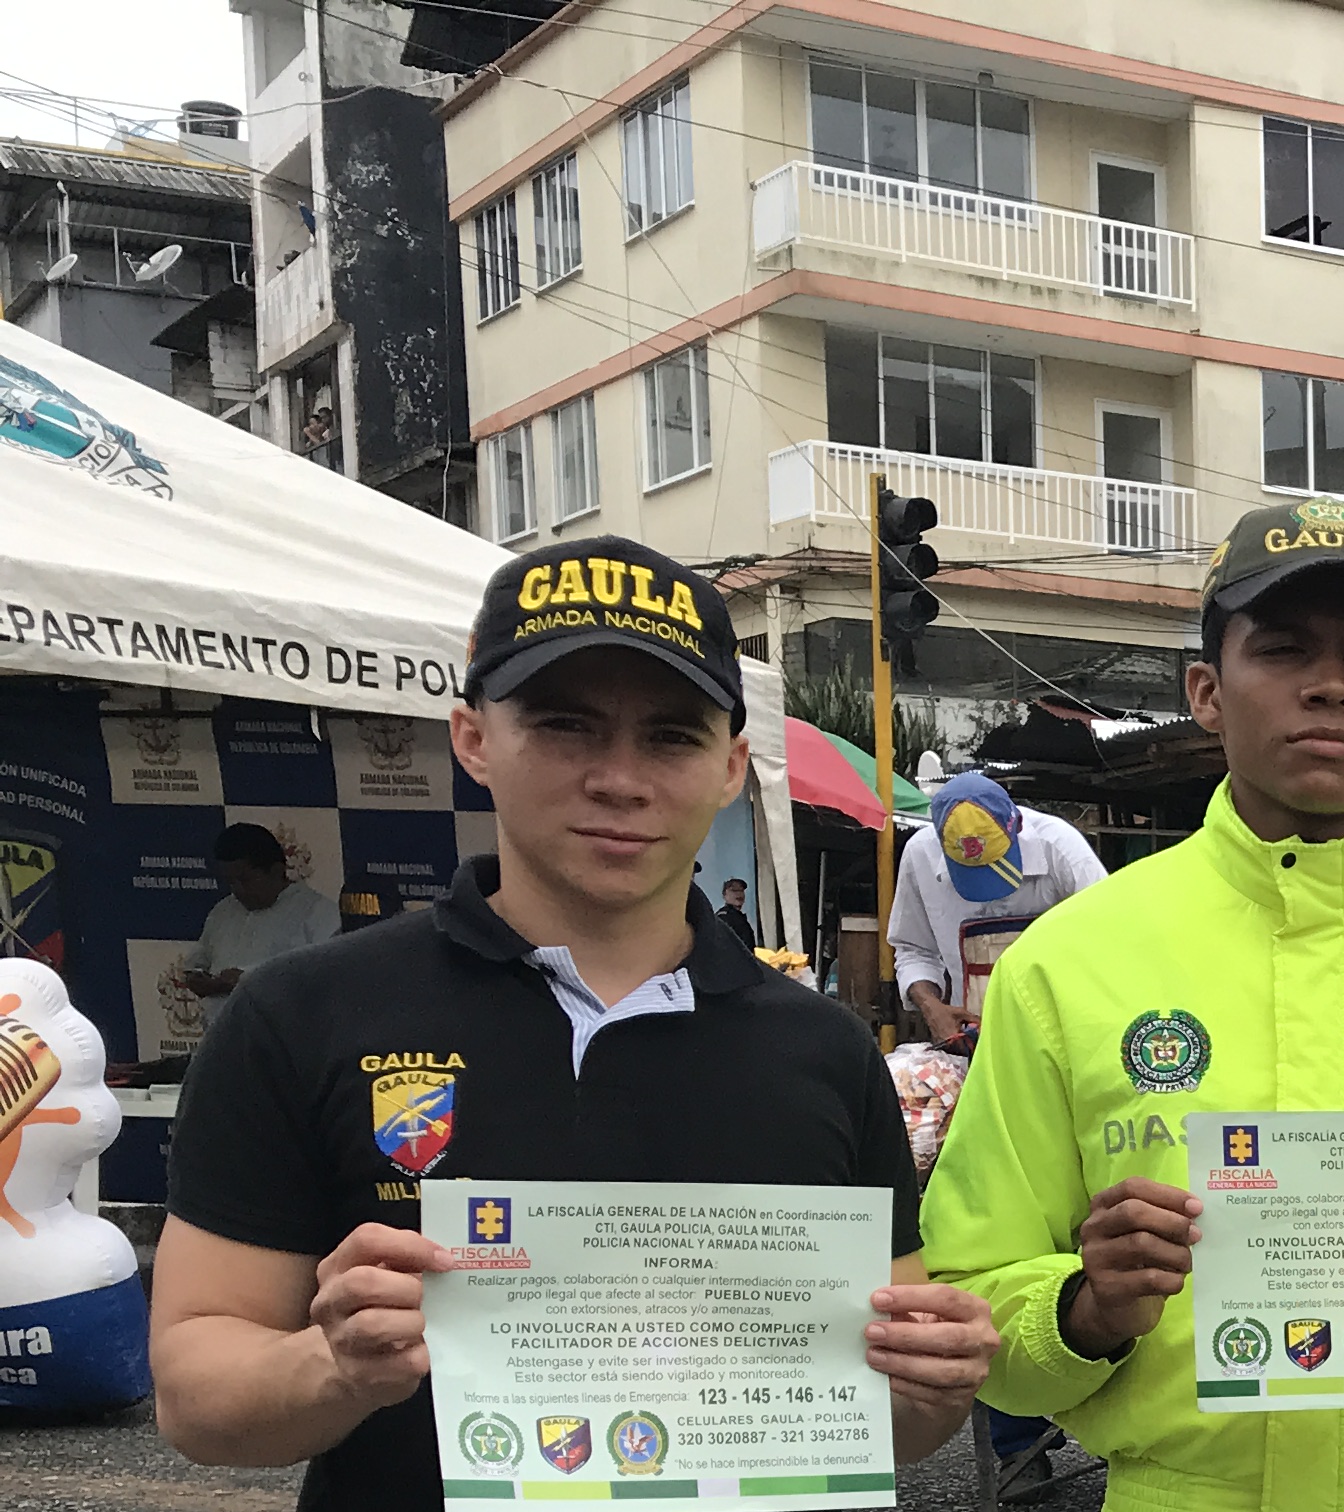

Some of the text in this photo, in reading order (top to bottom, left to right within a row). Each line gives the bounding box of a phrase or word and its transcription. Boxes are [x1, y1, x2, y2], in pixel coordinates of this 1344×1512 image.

[517, 558, 703, 631] GAULA
[514, 609, 705, 659] ARMADA NACIONAL
[326, 647, 379, 688] DE
[396, 656, 467, 699] POL
[21, 766, 86, 798] UNIFICADA
[19, 792, 86, 824] PERSONAL
[361, 1053, 466, 1072] GAULA
[377, 1074, 448, 1093] GAULA
[1210, 1168, 1274, 1180] FISCALIA
[1247, 1237, 1265, 1248] LO
[644, 1258, 719, 1269] INFORMA:
[705, 1289, 811, 1302] PUEBLO NUEVO
[491, 1323, 830, 1334] LO INVOLUCRAN A USTED COMO COMPLICE Y
[512, 1337, 811, 1349] FACILITADOR DE ACCIONES DELICTIVAS
[699, 1387, 858, 1405] 123 145 146 147
